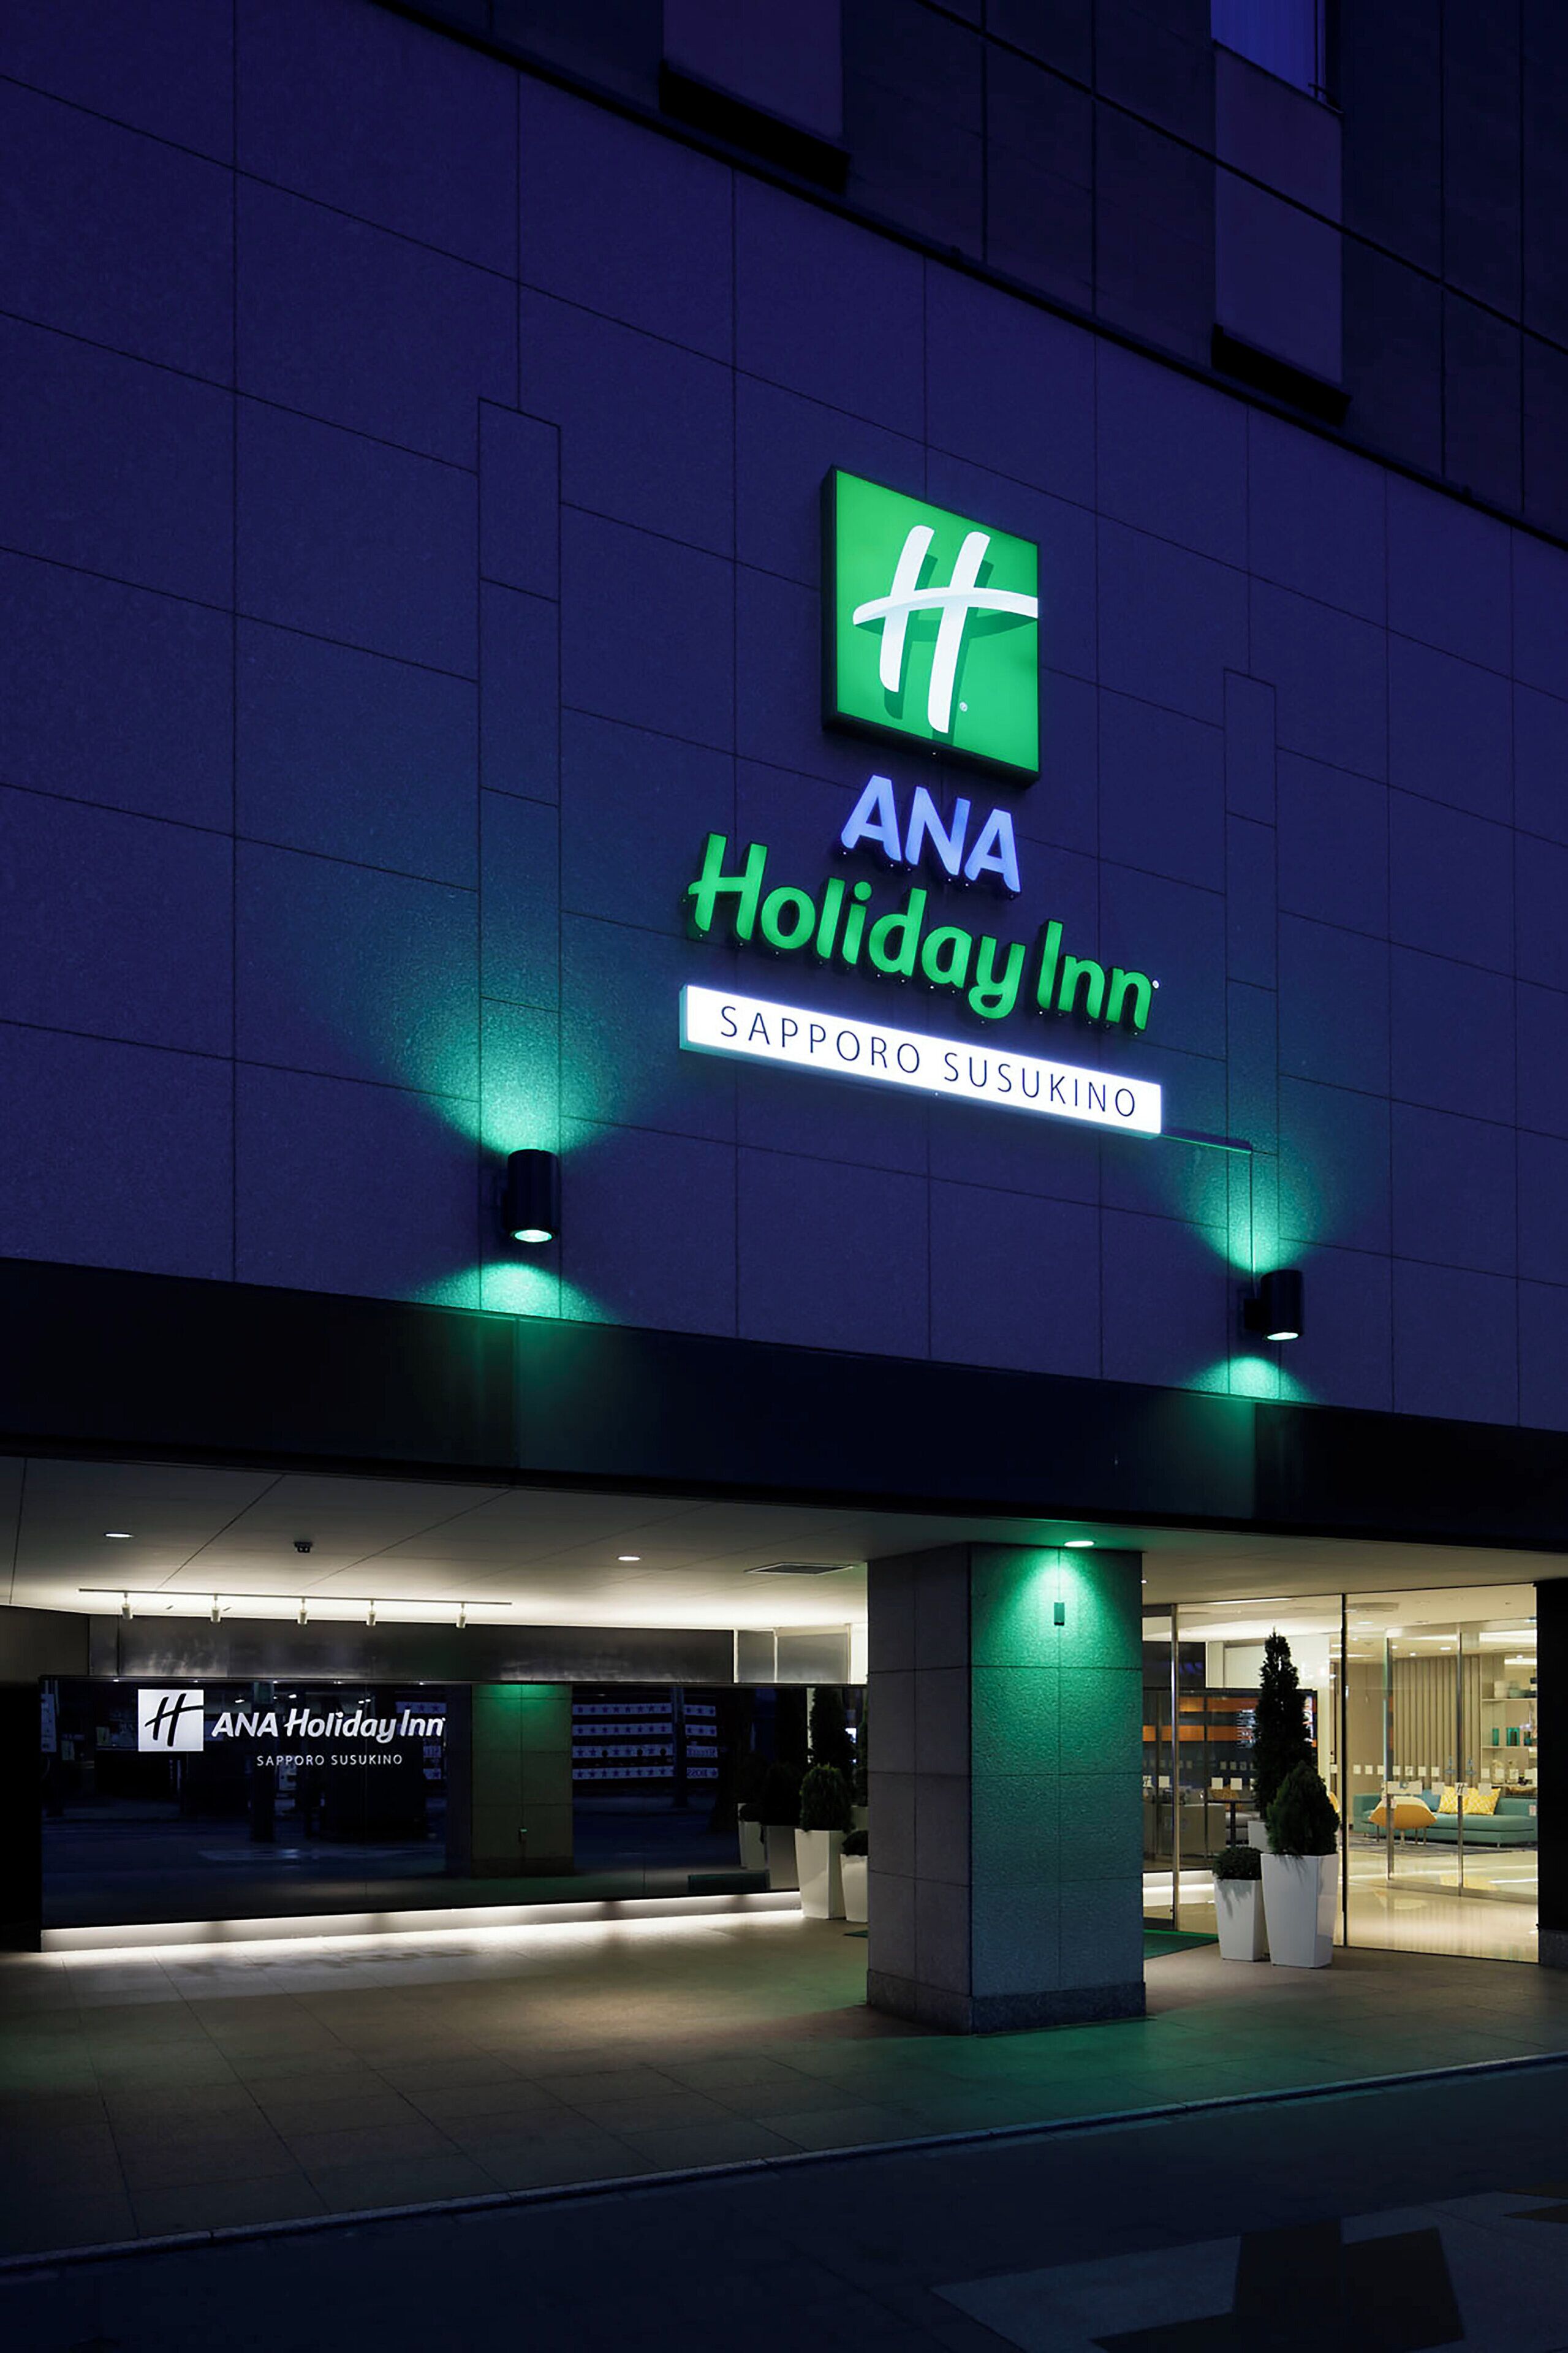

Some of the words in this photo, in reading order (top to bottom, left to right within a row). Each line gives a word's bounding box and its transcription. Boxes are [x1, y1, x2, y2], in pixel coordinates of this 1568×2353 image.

[841, 774, 1021, 893] ANA
[687, 832, 1026, 1020] Holiday
[1036, 919, 1153, 1031] Inn
[719, 1005, 920, 1074] SAPPORO
[944, 1051, 1135, 1118] SUSUKINO
[211, 1711, 279, 1738] ANA
[284, 1707, 397, 1744] Holiday
[400, 1708, 443, 1737] Inn
[257, 1754, 325, 1767] SAPPORO
[331, 1754, 403, 1765] SUSUKINO
